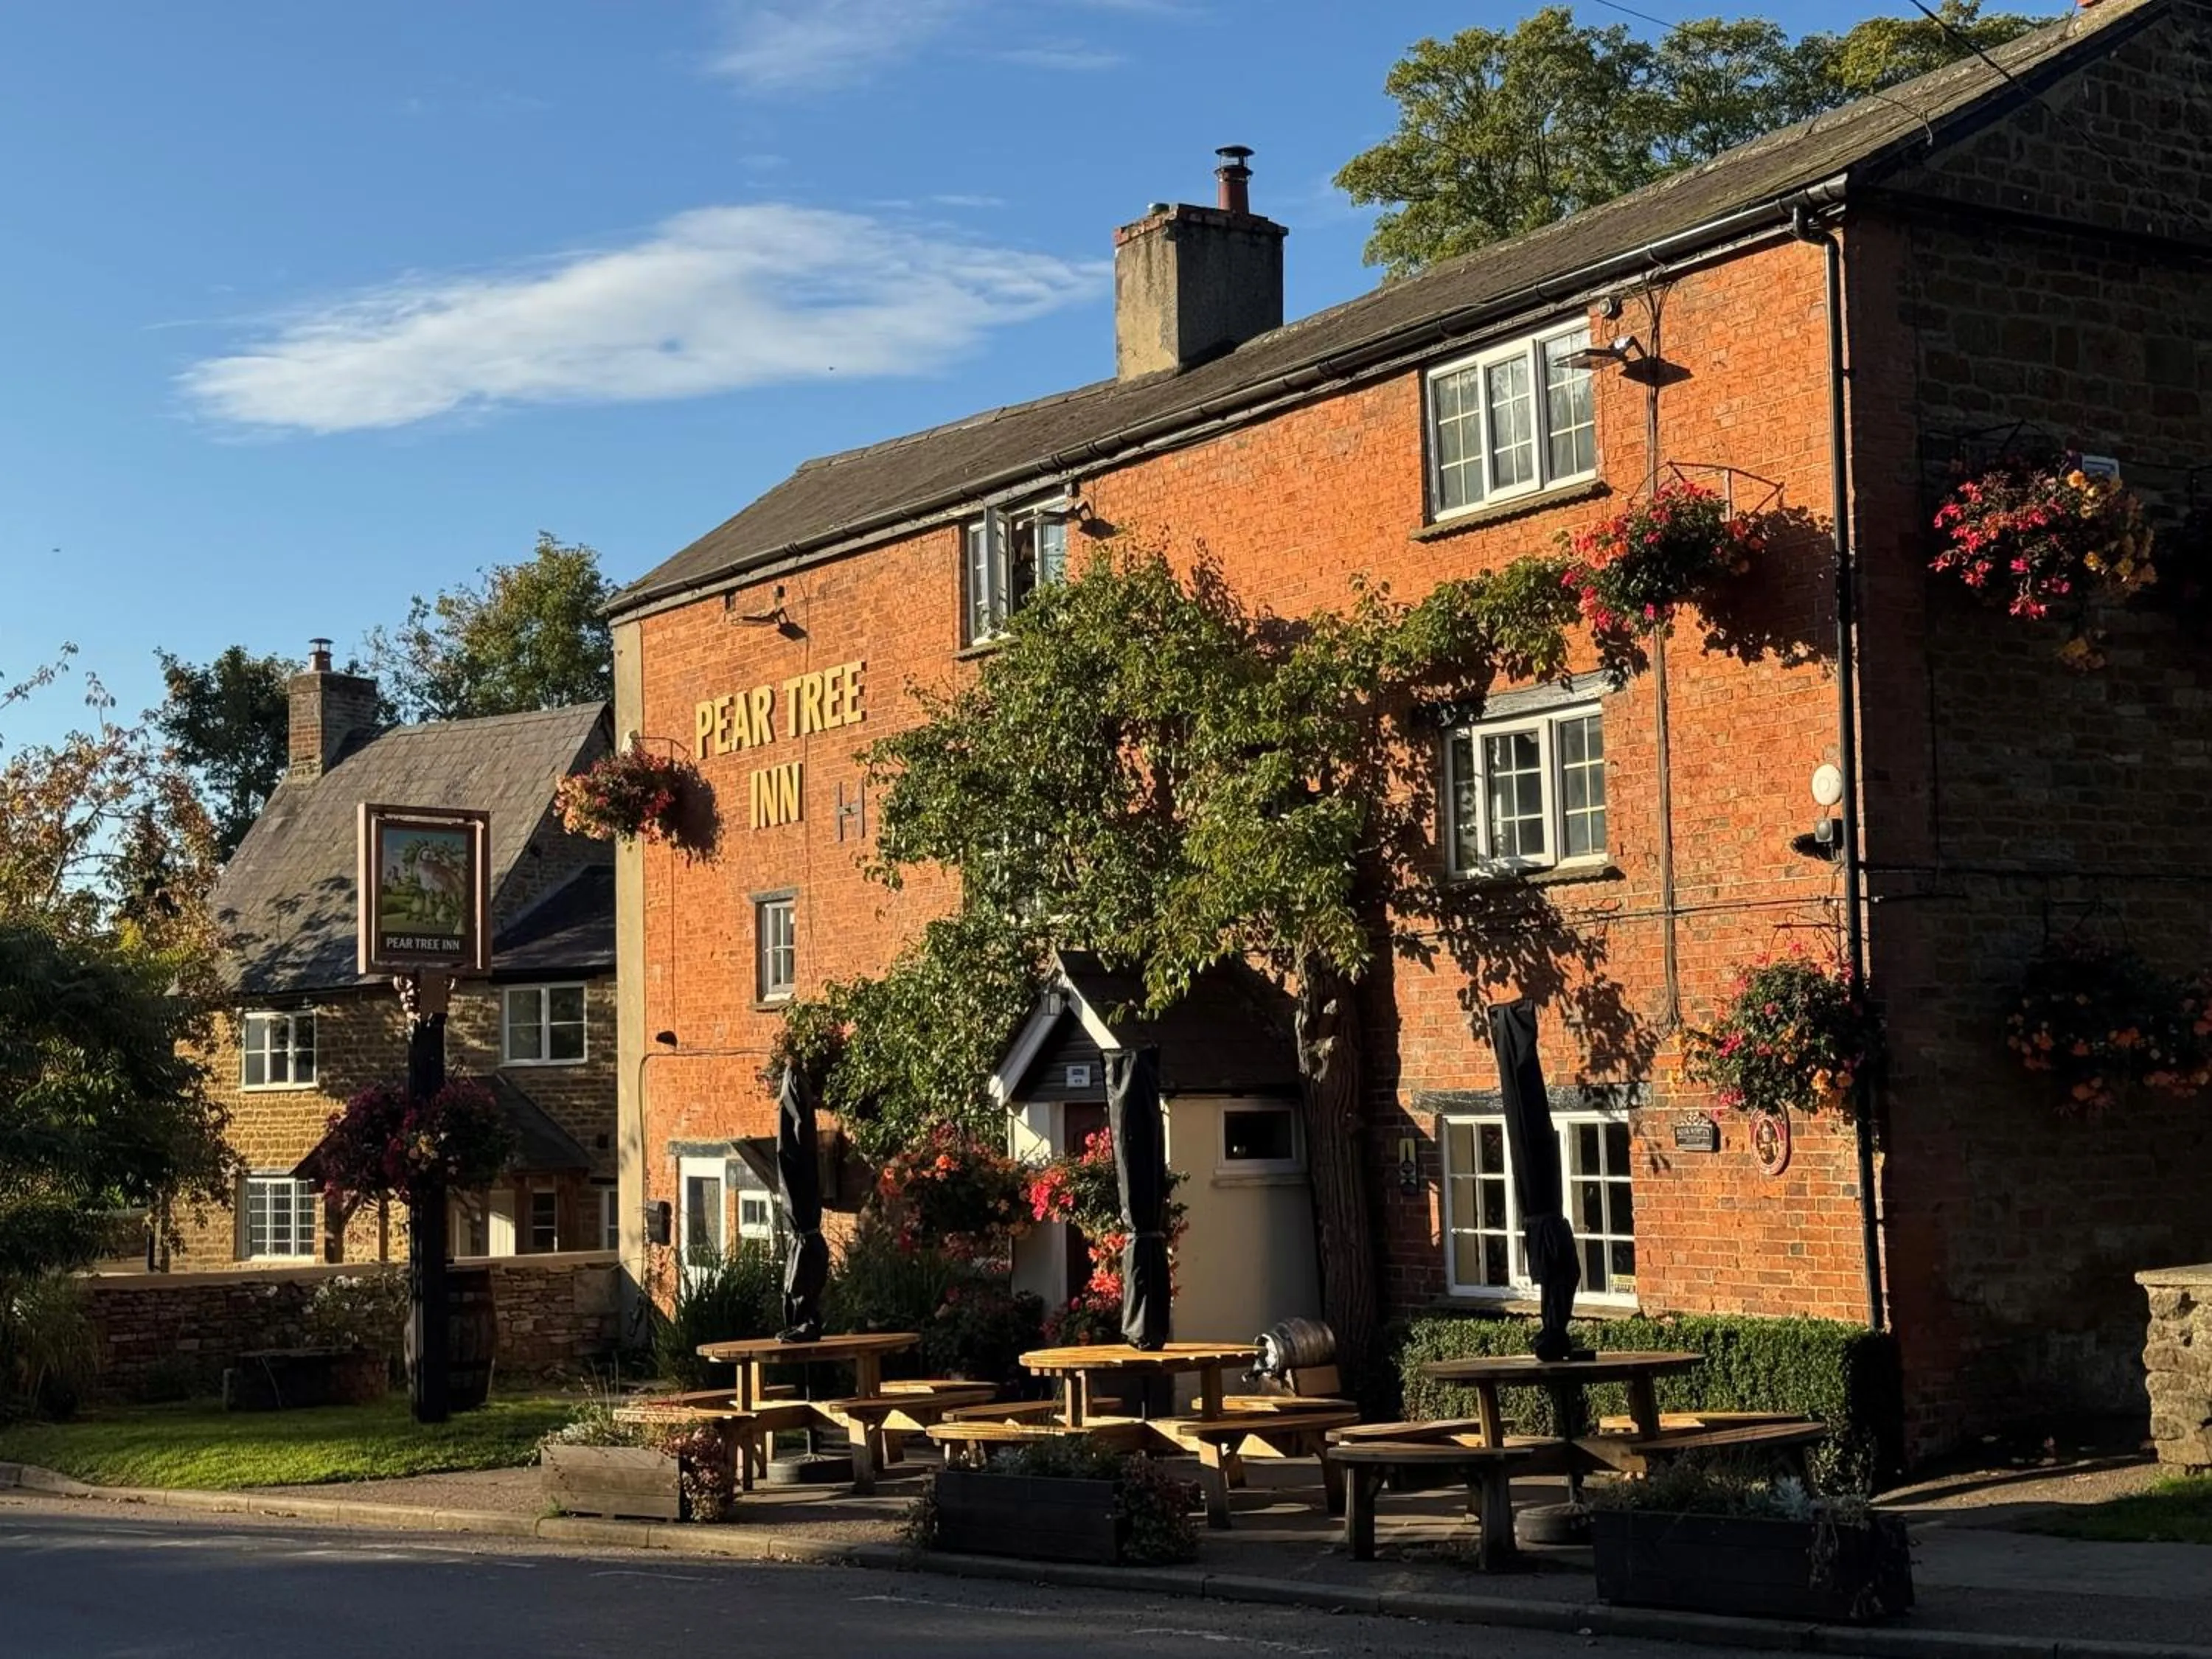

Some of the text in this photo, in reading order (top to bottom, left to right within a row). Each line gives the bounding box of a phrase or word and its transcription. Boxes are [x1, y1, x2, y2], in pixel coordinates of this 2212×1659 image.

[695, 661, 863, 759] PEAR TREE
[751, 761, 801, 830] INN
[386, 936, 460, 950] PEAR TREE INN
